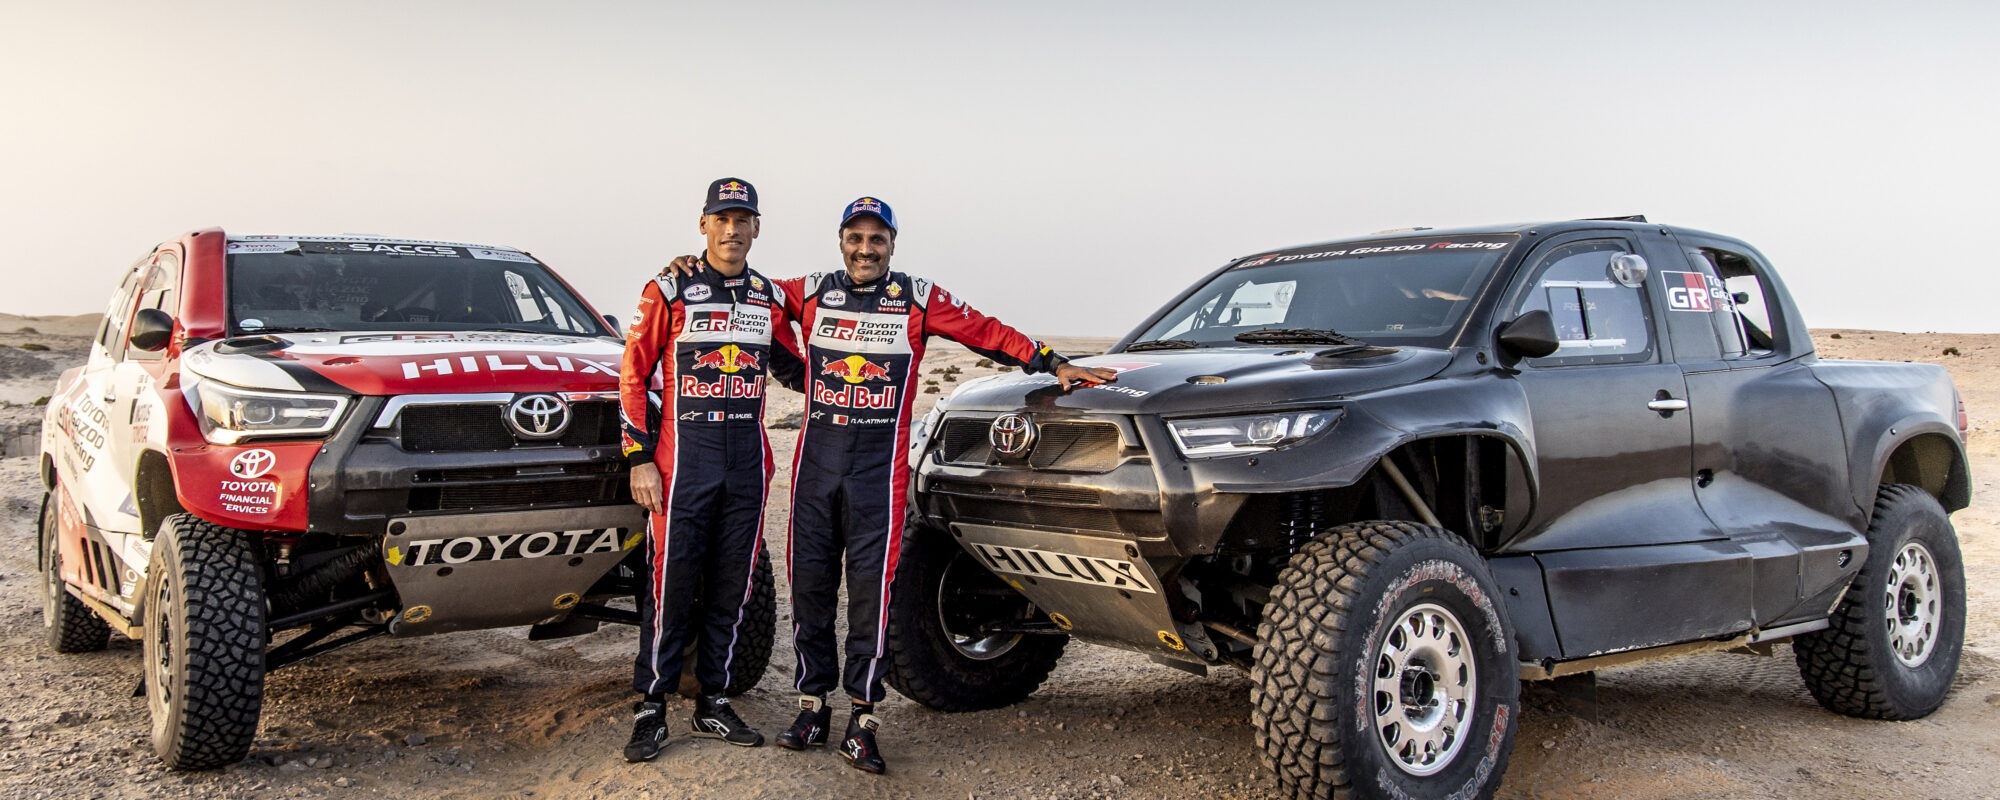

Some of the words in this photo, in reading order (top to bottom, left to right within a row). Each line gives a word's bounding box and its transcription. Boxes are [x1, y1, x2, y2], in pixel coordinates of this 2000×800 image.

[719, 192, 734, 201] Red
[735, 192, 749, 202] Bull
[348, 243, 458, 255] SACCS
[1274, 250, 1348, 262] TOYOTA
[1428, 241, 1509, 250] Racing
[747, 289, 769, 302] Qatar
[880, 297, 907, 307] Qatar
[1668, 286, 1712, 311] GR
[736, 311, 769, 322] TOYOTA
[690, 317, 728, 333] GR
[729, 324, 764, 336] Racing
[859, 321, 903, 330] TOYOTA
[818, 323, 854, 341] GR
[854, 335, 895, 345] Racing
[401, 354, 620, 380] HILUX
[681, 375, 728, 398] Red
[730, 375, 765, 399] Bull
[813, 379, 852, 408] Red
[852, 385, 898, 410] Bull
[221, 481, 277, 493] TOYOTA
[219, 493, 272, 505] FINANCIAL
[408, 527, 621, 567] TOYOTA
[976, 544, 1151, 590] HILUX
